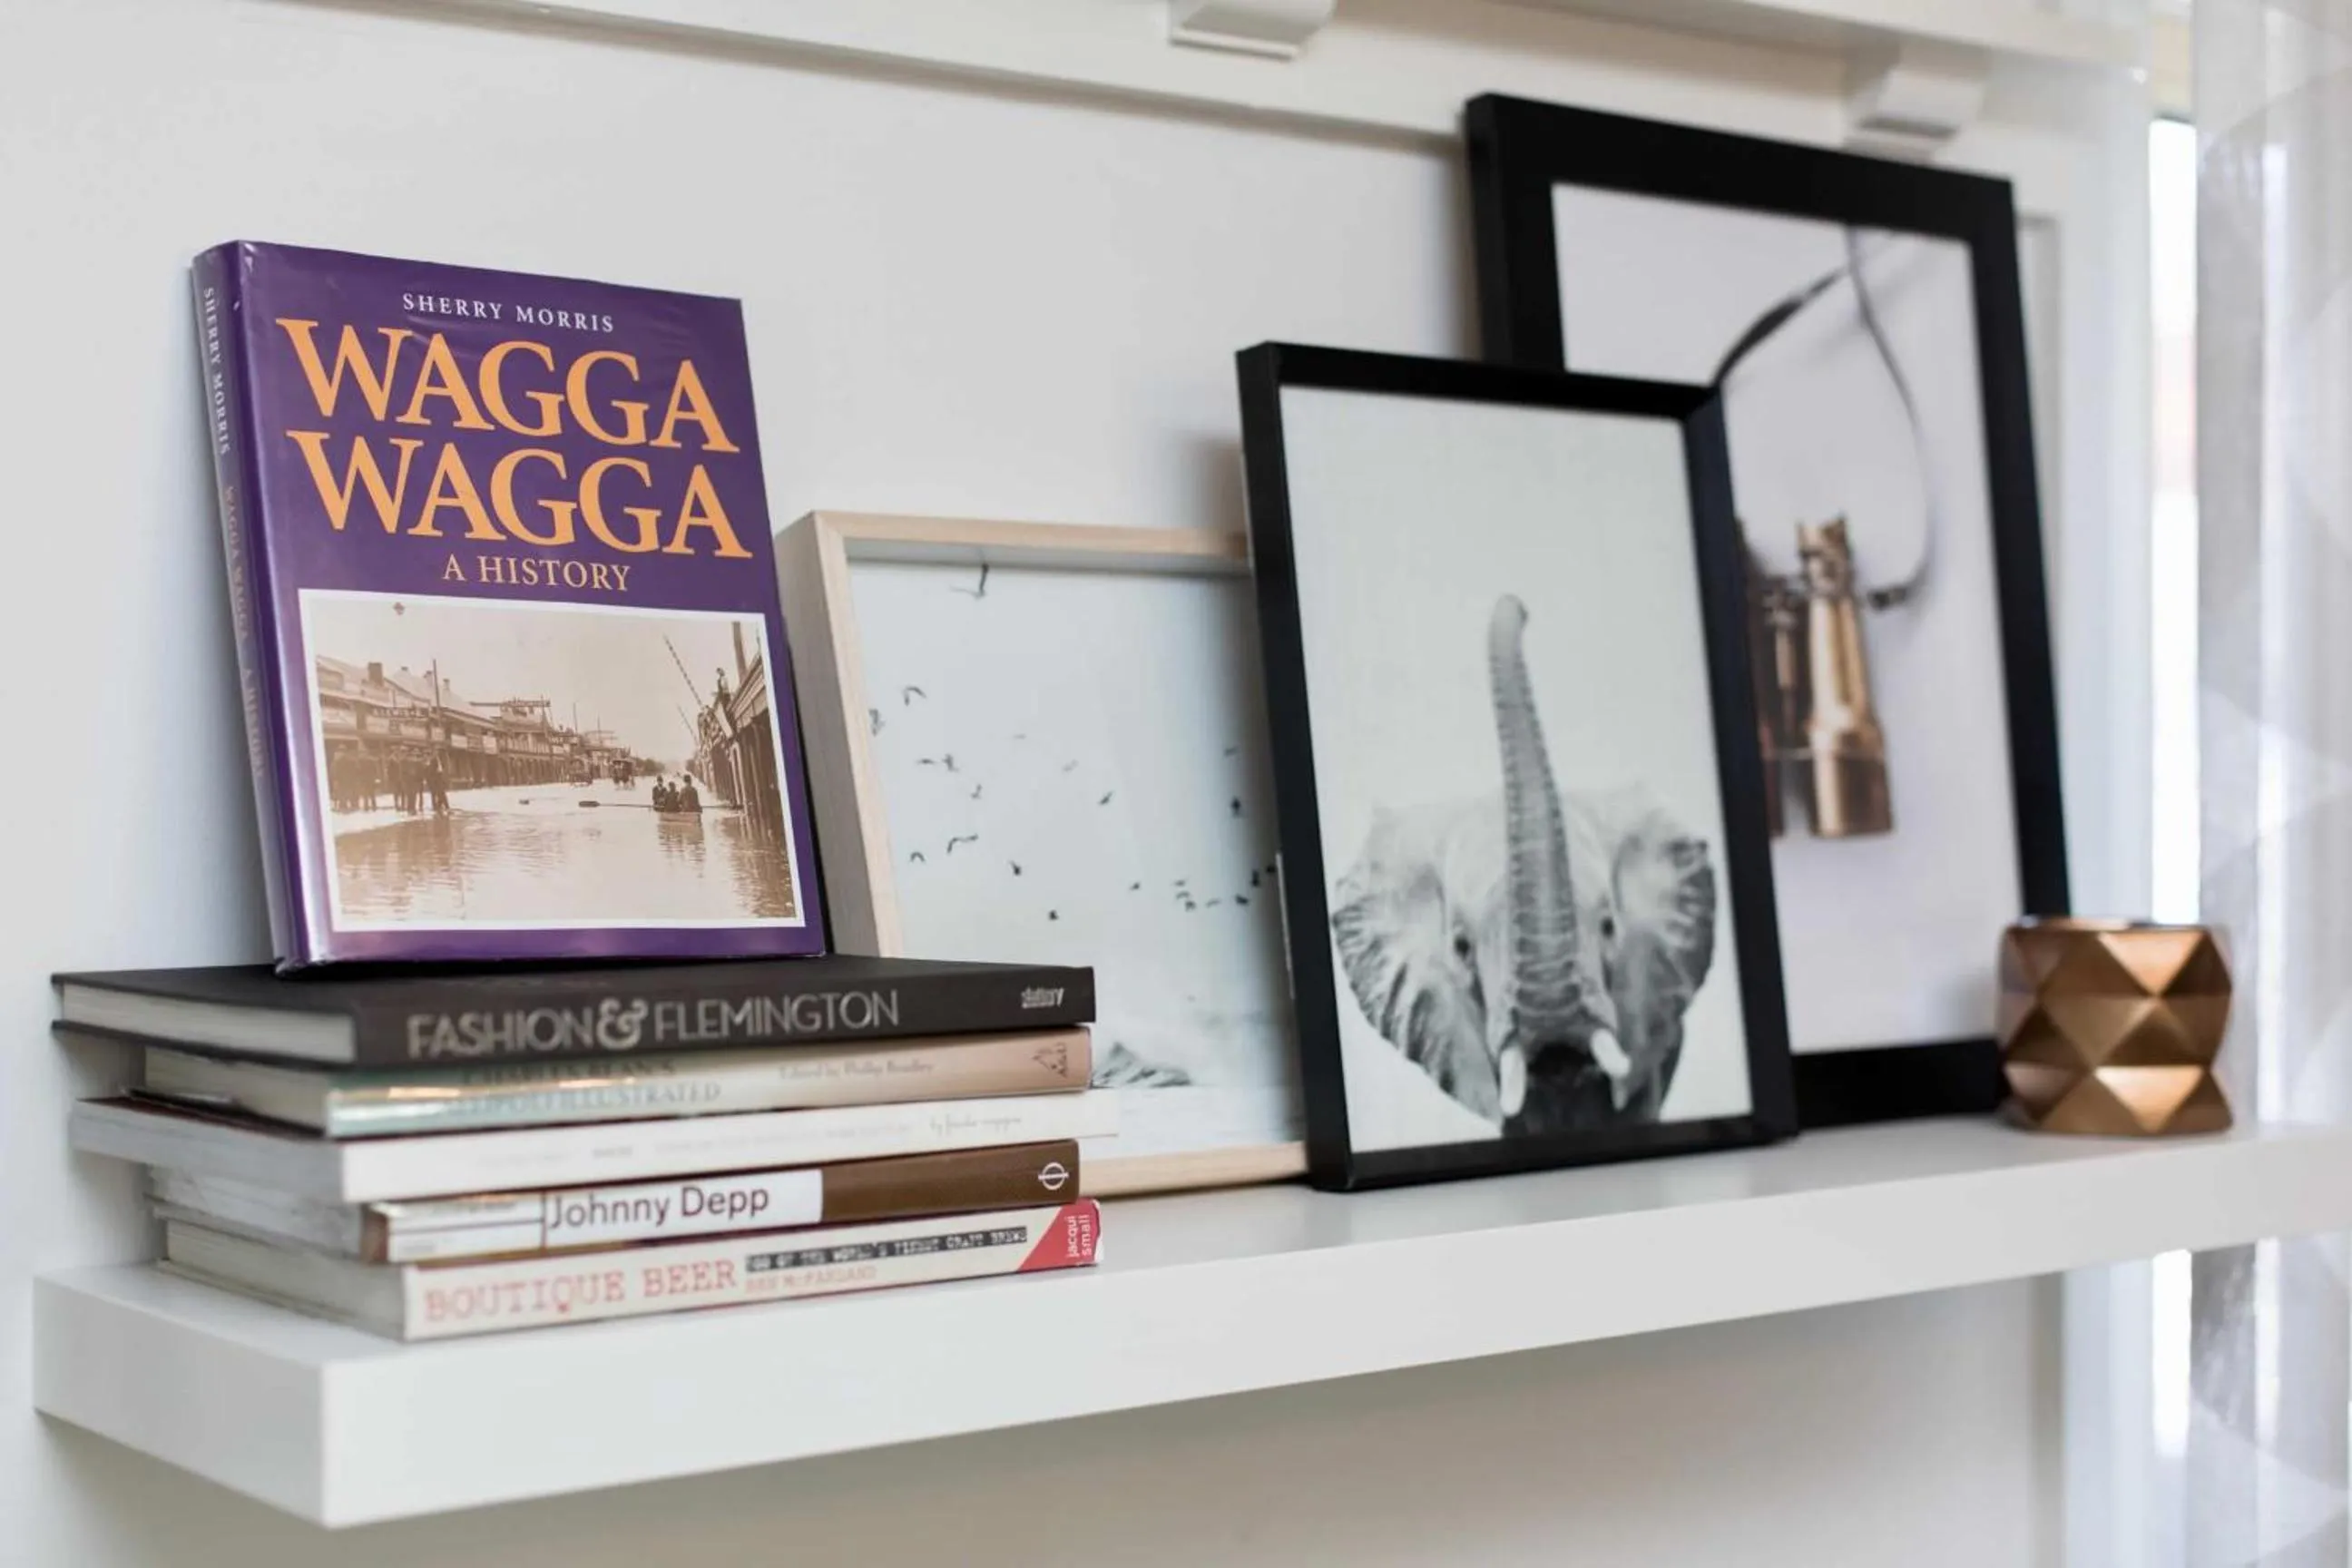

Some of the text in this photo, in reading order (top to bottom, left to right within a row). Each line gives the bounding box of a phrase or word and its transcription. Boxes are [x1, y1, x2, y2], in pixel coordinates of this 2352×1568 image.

[403, 292, 614, 333] SHERRY MORRIS
[276, 318, 740, 453] WAGGA
[287, 429, 753, 559] WAGGA
[442, 554, 631, 593] A HISTORY
[655, 989, 898, 1042] FLEMINGTON
[548, 1190, 671, 1230] Johnny
[681, 1185, 769, 1220] Depp
[1063, 1214, 1080, 1258] jacqui
[1078, 1214, 1093, 1257] small
[424, 1259, 738, 1323] BOUTIQUE BEER
